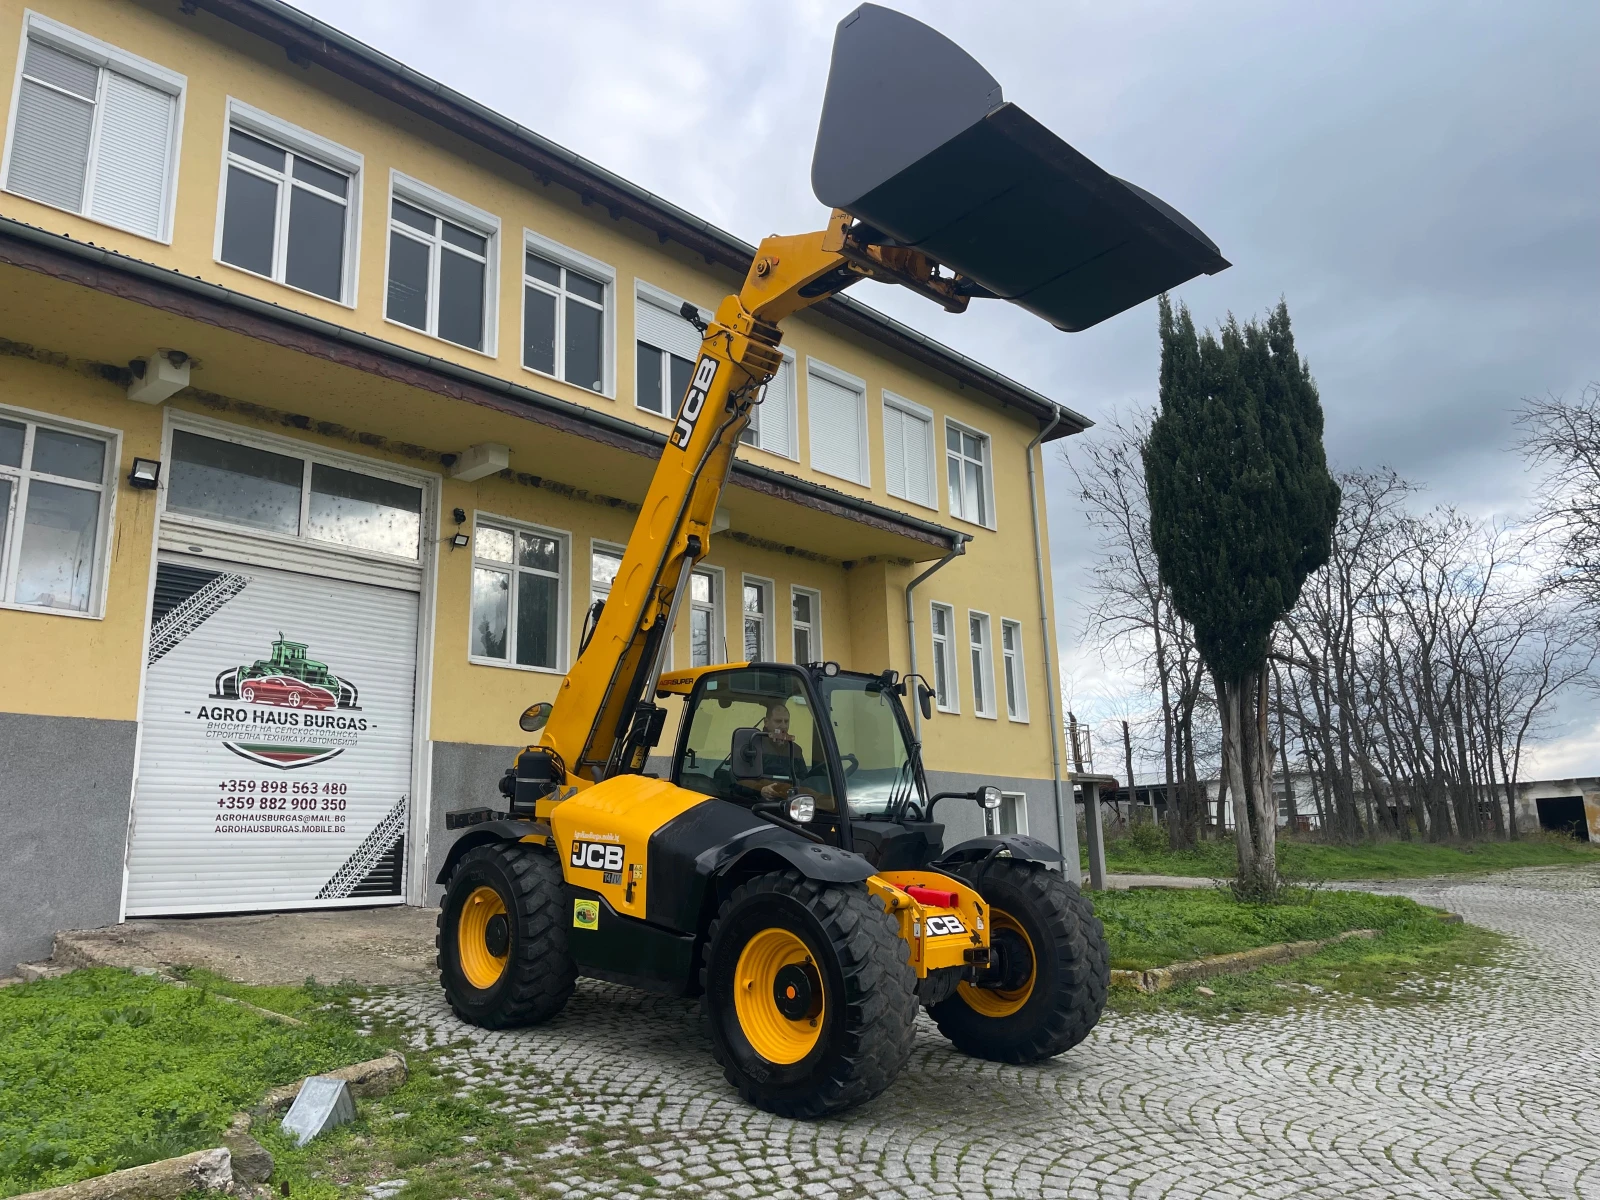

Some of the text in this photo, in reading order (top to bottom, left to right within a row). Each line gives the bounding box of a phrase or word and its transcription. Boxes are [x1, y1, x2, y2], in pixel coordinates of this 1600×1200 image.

[677, 357, 718, 449] JCB
[659, 677, 694, 686] AGRISUPER
[197, 705, 248, 723] AGRO
[253, 709, 300, 726] HAUS
[304, 714, 368, 731] BURGAS
[205, 730, 261, 741] СТРОИТЕЛНА
[262, 734, 298, 743] ТЕХНИКА
[306, 736, 358, 747] АВТОМОБИЛИ
[206, 721, 359, 739] ВНОСИТЕЛ НА СЕЛСКОСТОПАНСКА
[218, 779, 347, 795] +359 898 563 480
[216, 796, 347, 811] +359 882 900 350
[215, 813, 346, 824] AGROHAUSBURGAS@MAIL.BG
[214, 825, 346, 833] AGROHAUSBURGAS.MOBILE.BG
[572, 843, 624, 871] JCB
[926, 916, 965, 936] CB
